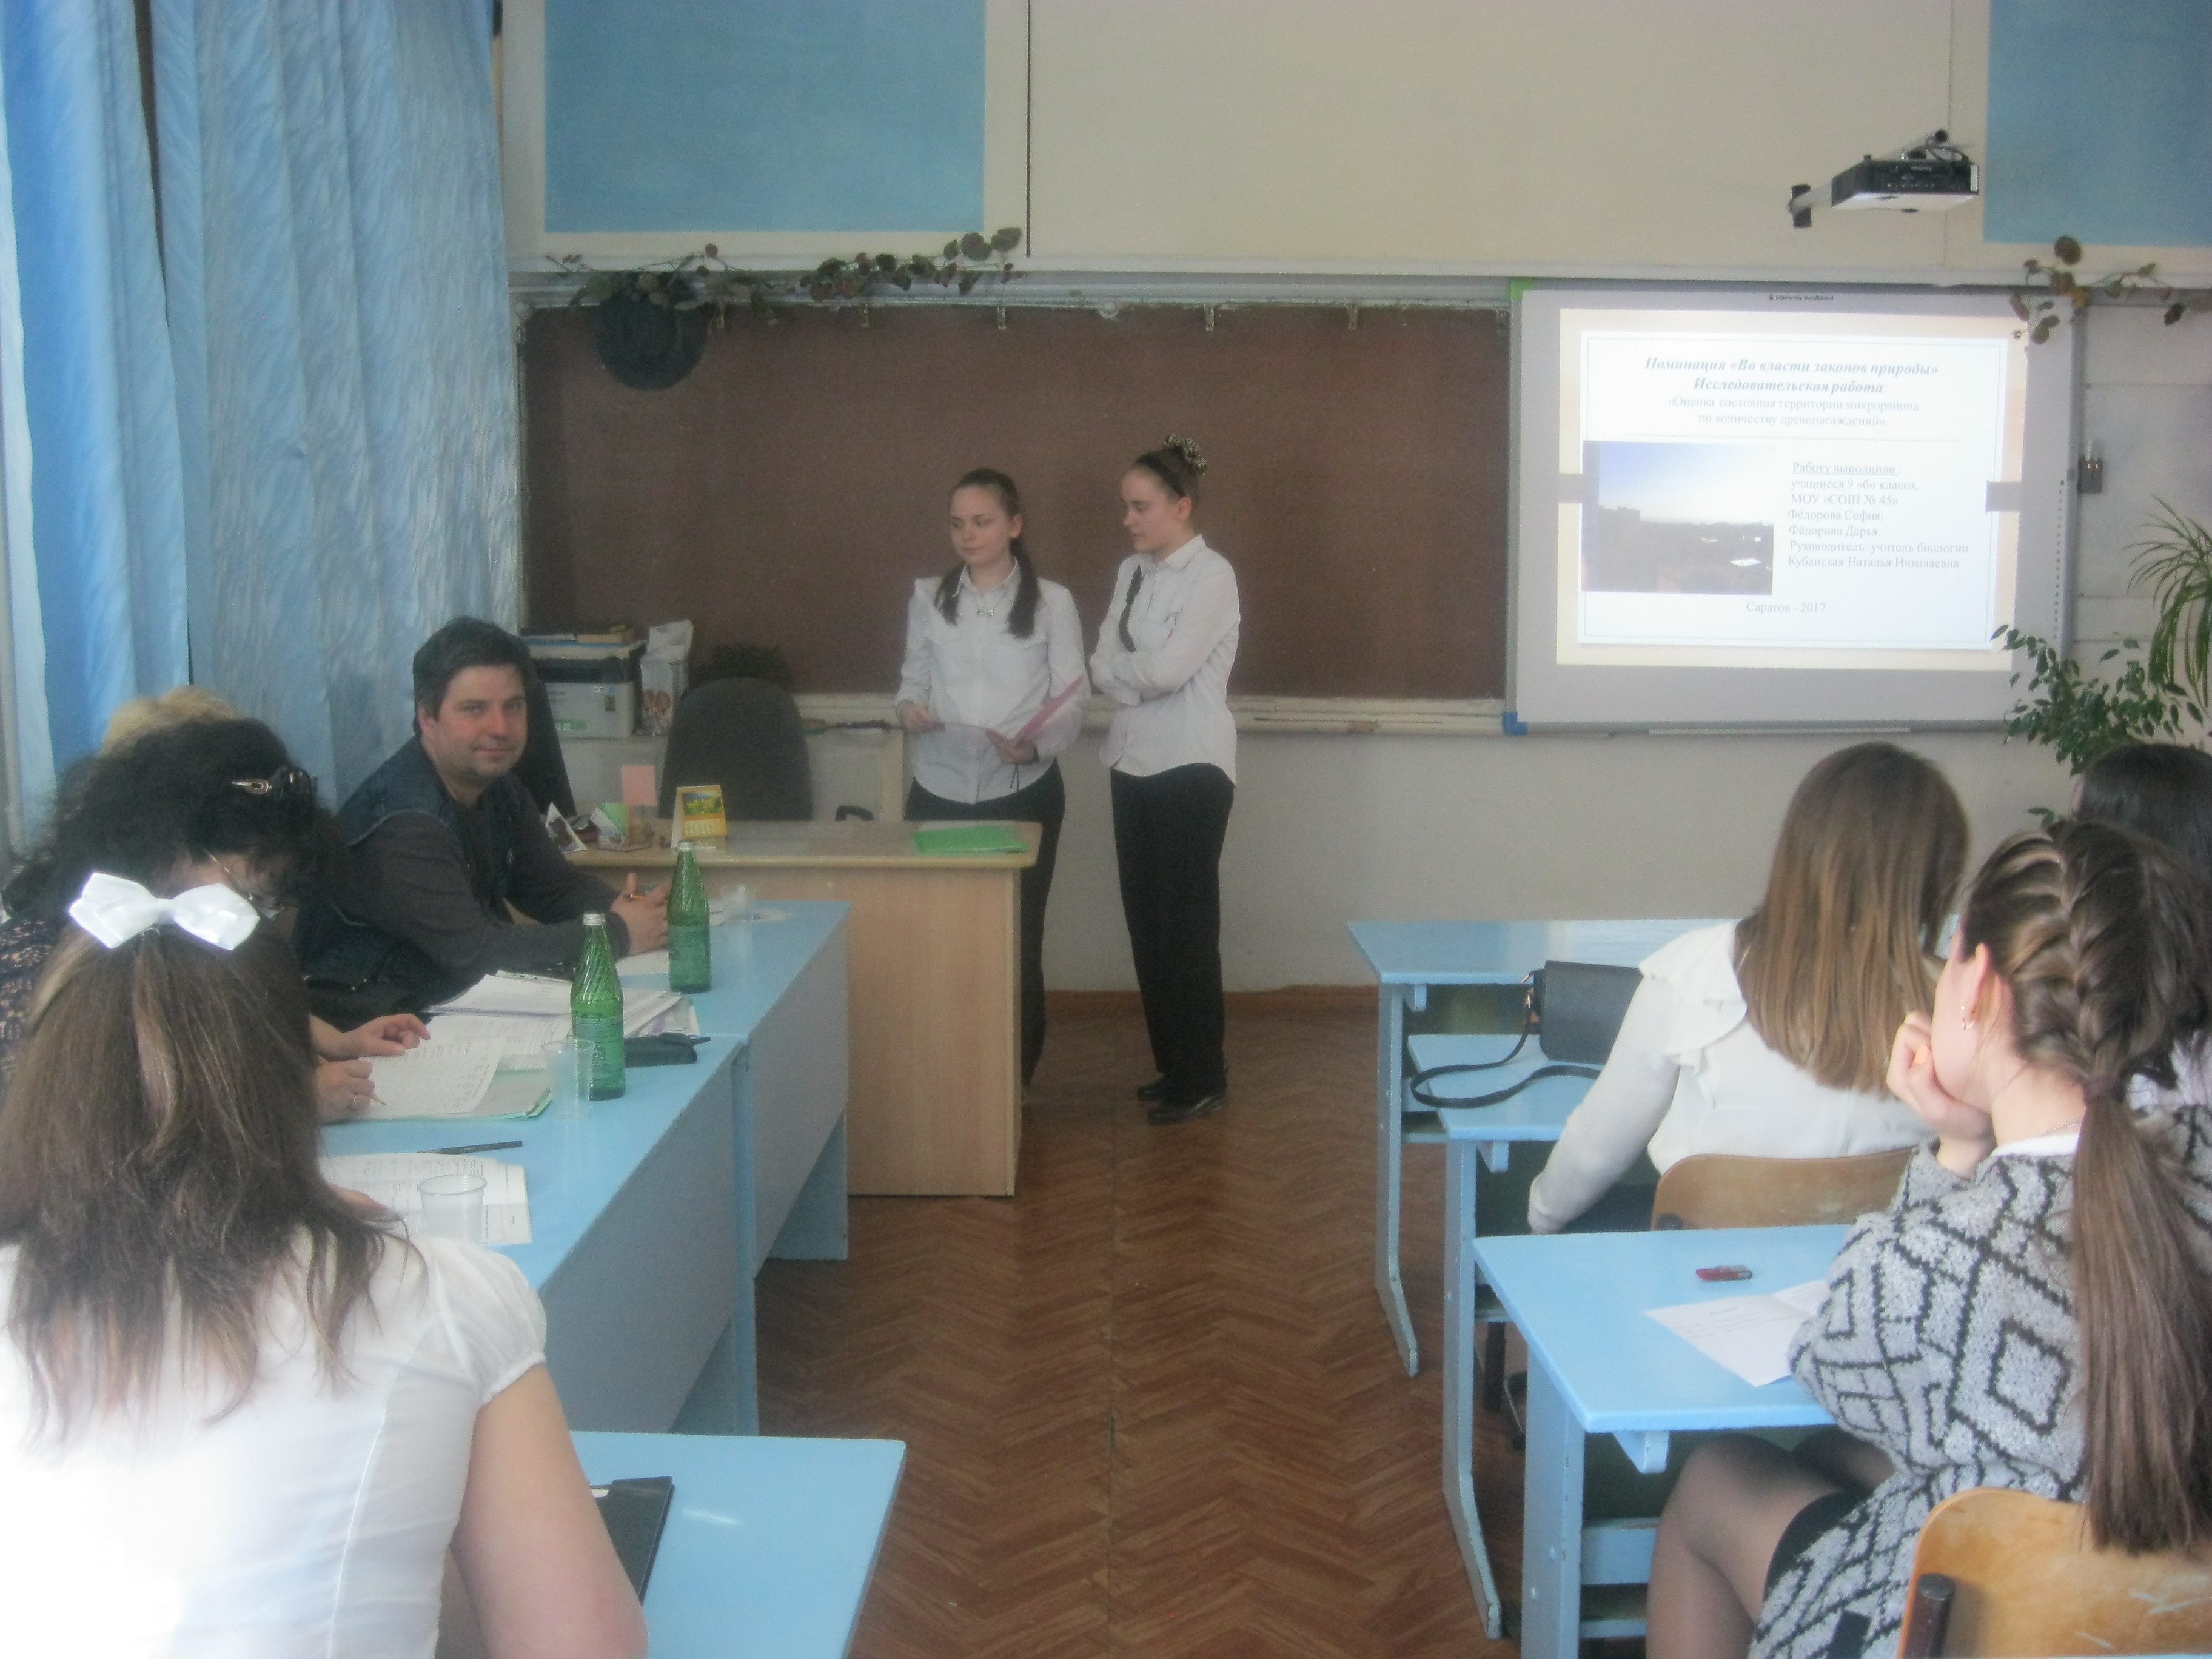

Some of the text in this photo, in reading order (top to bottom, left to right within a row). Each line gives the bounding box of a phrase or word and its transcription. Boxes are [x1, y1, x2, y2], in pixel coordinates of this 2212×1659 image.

[1645, 358, 1938, 377] Номинация «Во власти законов природы»
[1694, 378, 1829, 393] Исследовательская
[1669, 397, 1919, 412] «Оценка состояния территории микрорайона
[1698, 414, 1712, 423] по
[1715, 415, 1777, 426] количеству
[1792, 462, 1830, 475] Работу
[1791, 480, 1844, 490] учащиеся
[1847, 480, 1853, 489] 9
[1879, 482, 1918, 492] класса,
[1791, 494, 1898, 505] МОУ «СОШ № 45»
[1788, 509, 1884, 522] Фёдорова София;
[1789, 525, 1842, 537] Фёдорова
[1790, 541, 1968, 554] Руководитель: учитель биологии
[1788, 556, 1959, 568] Кубанская Наталья Николаевна
[1746, 602, 1790, 614] Саратов
[1800, 603, 1826, 613] 2017
